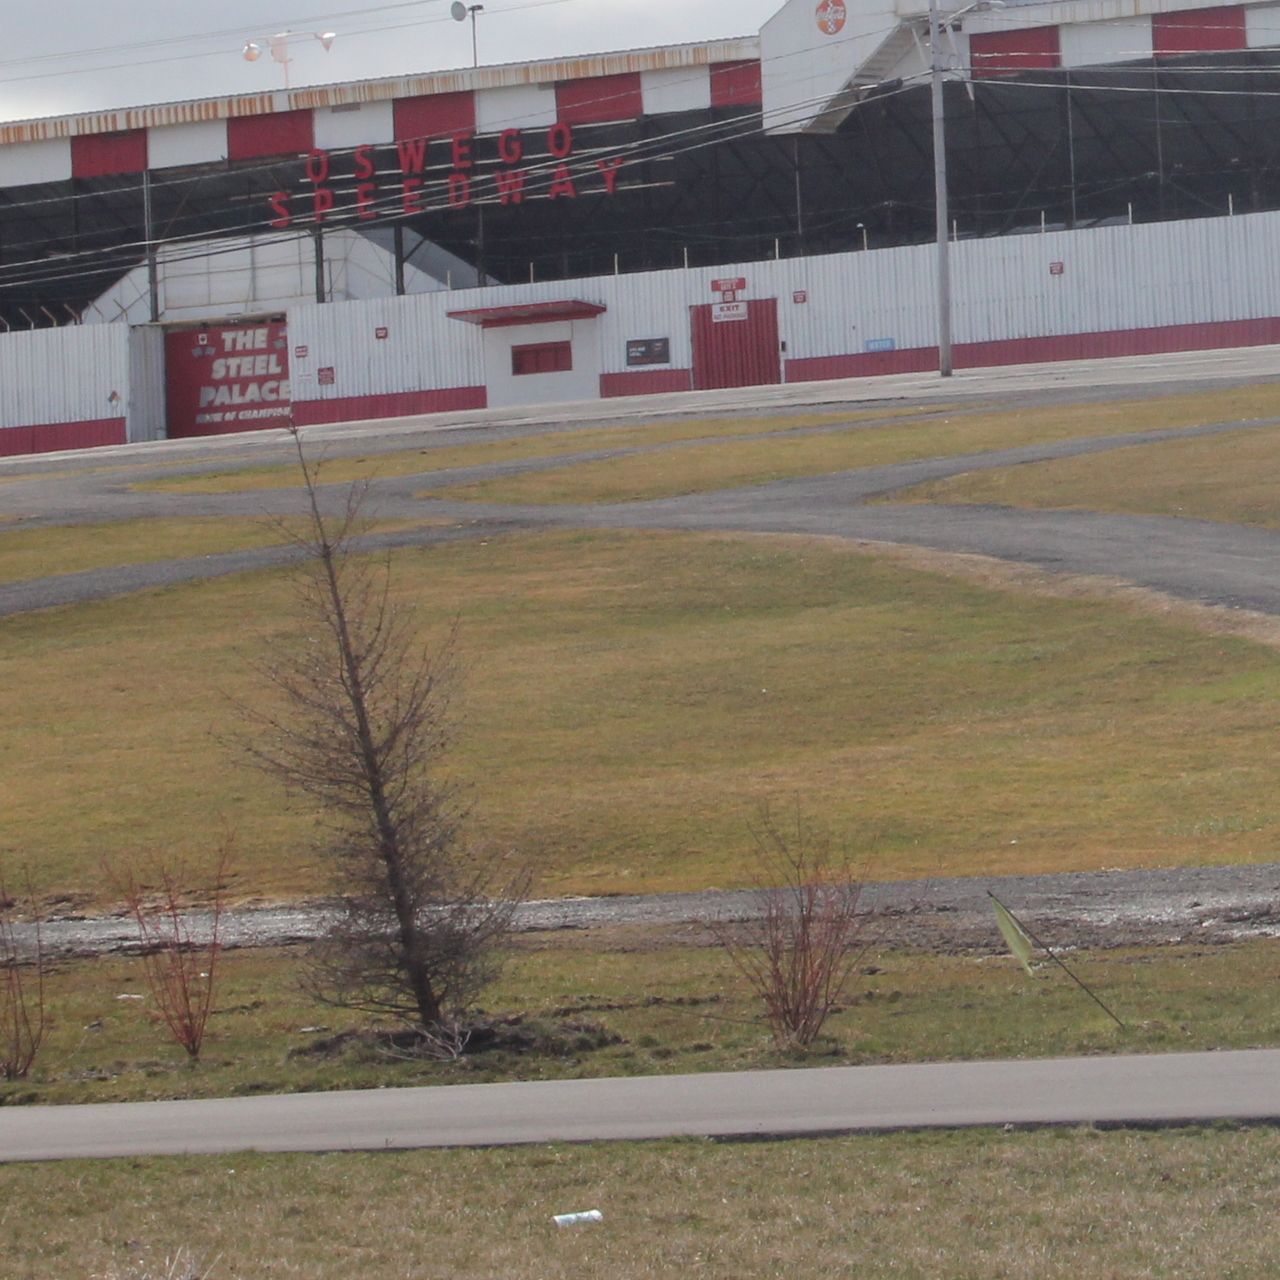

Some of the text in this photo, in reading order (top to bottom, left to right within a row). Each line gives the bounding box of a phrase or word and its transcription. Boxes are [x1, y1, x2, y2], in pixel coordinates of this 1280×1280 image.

[305, 122, 573, 184] OSWEGO
[270, 157, 622, 228] SPEEDWAY
[720, 304, 740, 312] EXIT
[221, 327, 269, 352] THE
[211, 354, 282, 380] STEEL
[199, 380, 291, 408] PALACE
[223, 411, 237, 421] OF
